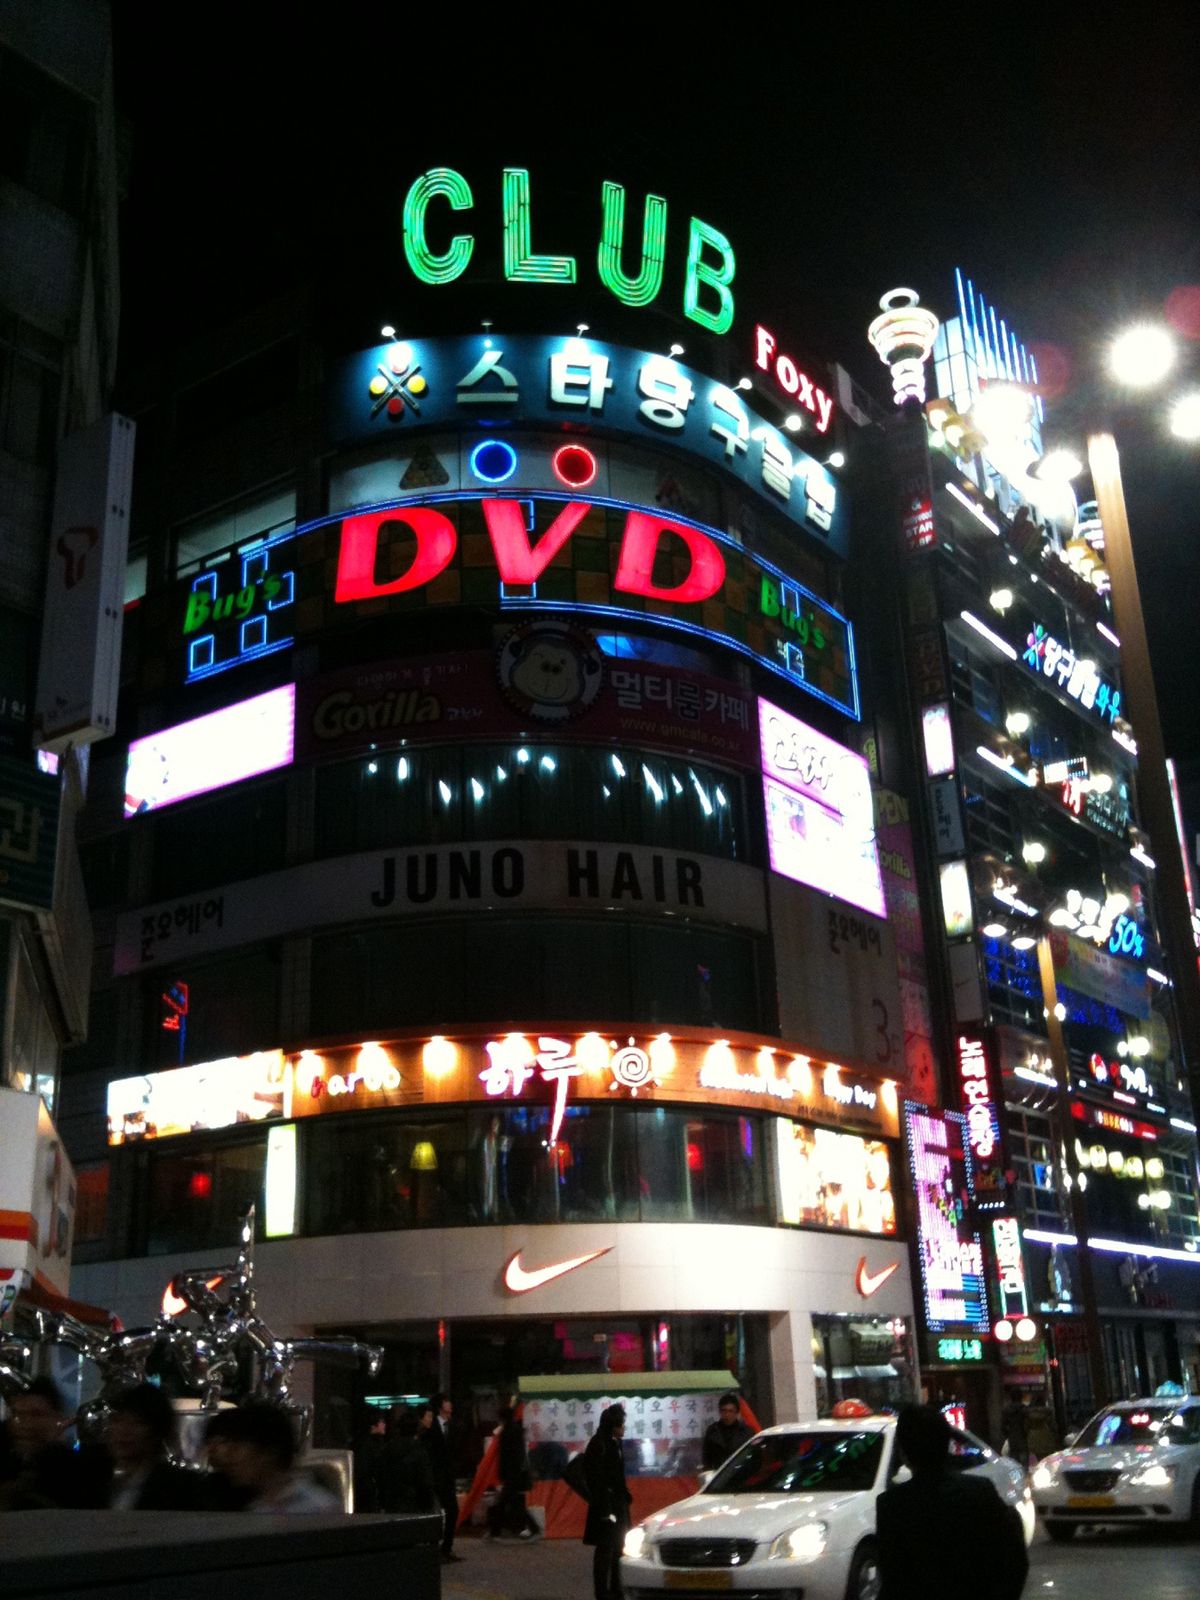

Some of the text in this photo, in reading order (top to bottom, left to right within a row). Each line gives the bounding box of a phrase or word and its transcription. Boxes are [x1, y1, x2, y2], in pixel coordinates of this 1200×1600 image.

[402, 167, 736, 334] CLUB
[335, 499, 727, 603] DVD
[184, 570, 282, 634] Bug's
[760, 574, 826, 649] Bug's
[313, 689, 442, 740] Gorilla
[610, 670, 750, 732] 멀티룸카페
[371, 847, 704, 907] JUNO HAIR
